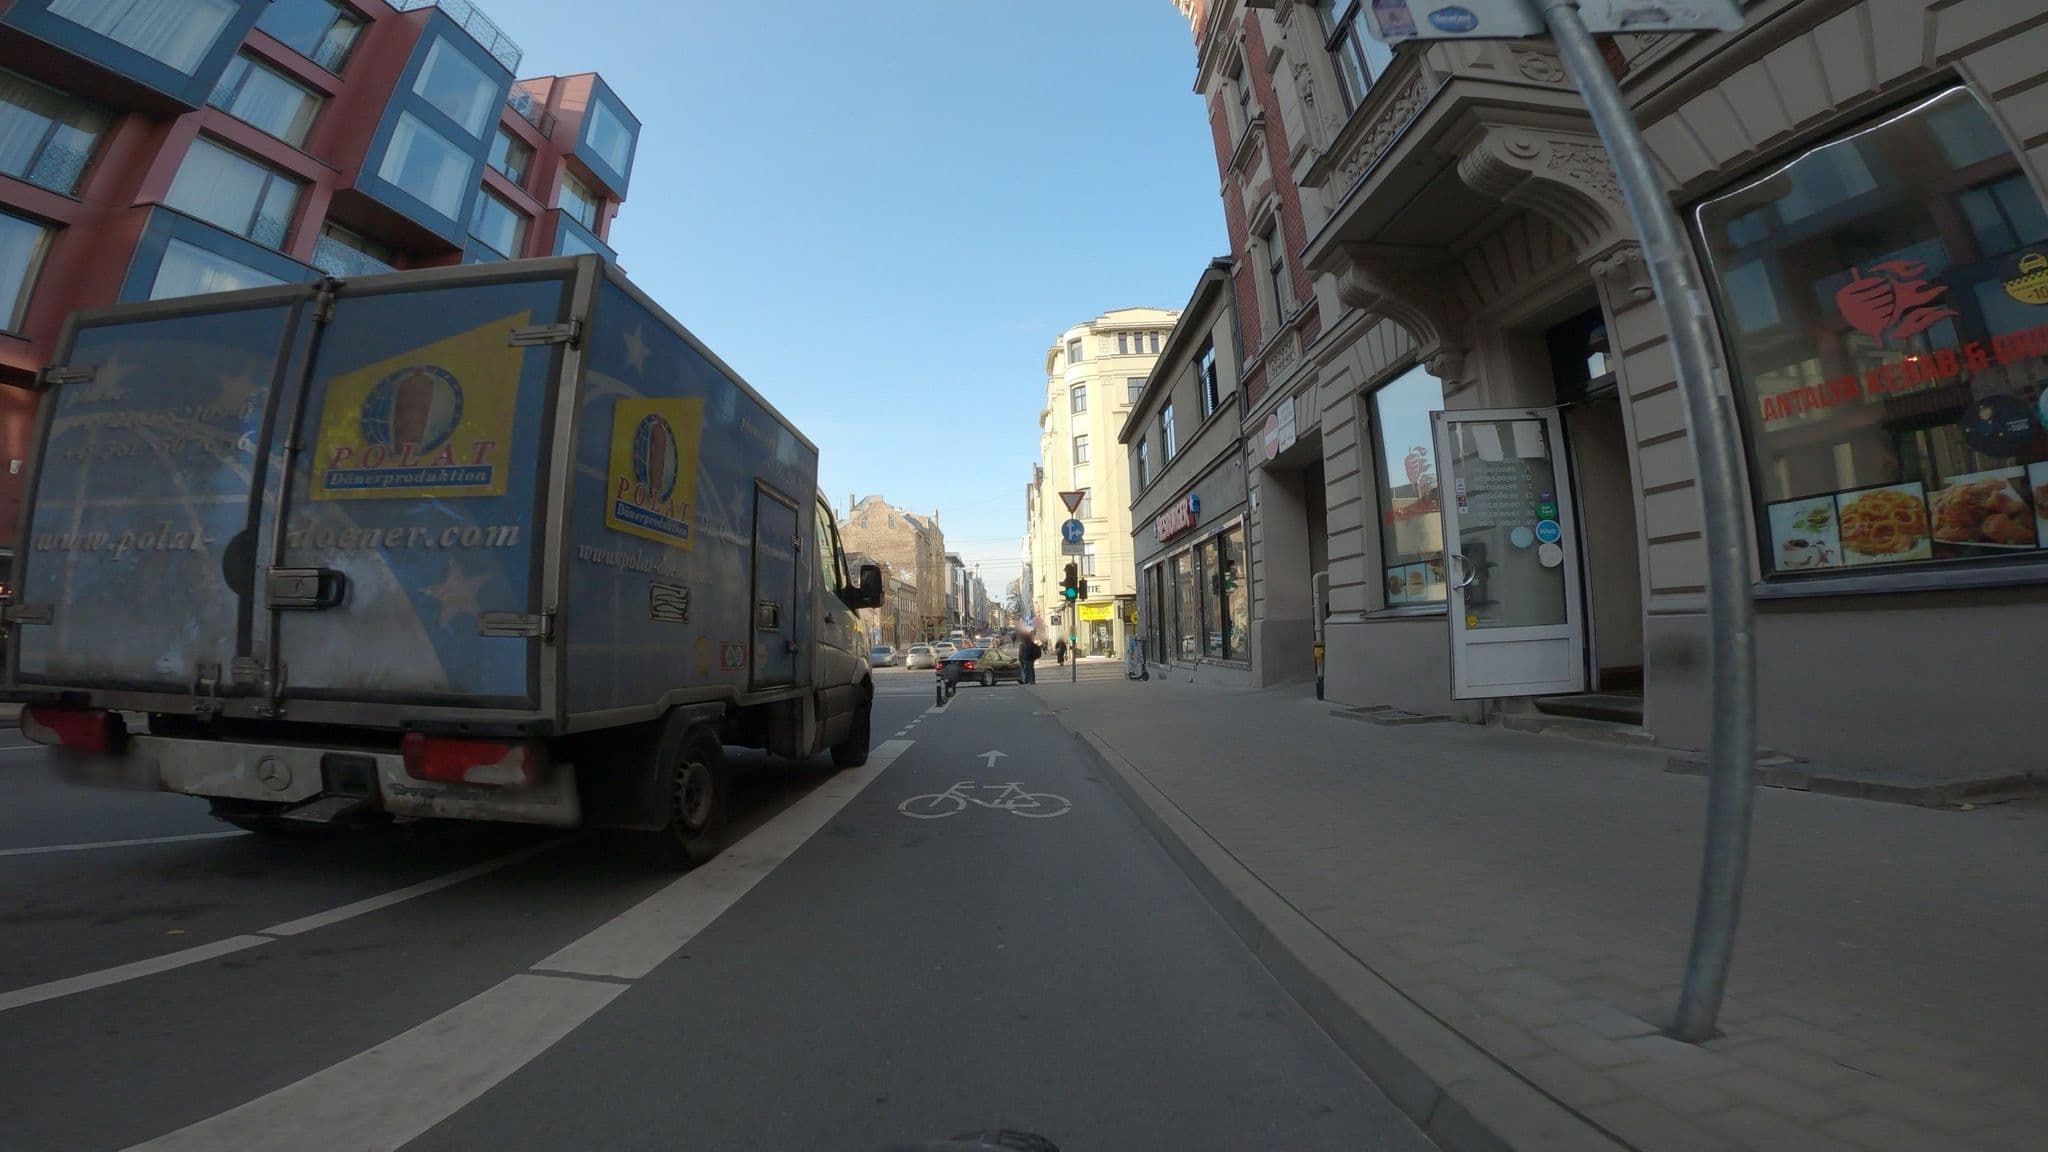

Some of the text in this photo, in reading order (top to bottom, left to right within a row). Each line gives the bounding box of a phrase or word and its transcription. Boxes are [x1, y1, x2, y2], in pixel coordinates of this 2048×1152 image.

[1764, 373, 1861, 423] ANTALYA
[1864, 348, 1959, 394] KEBAB
[1965, 341, 1989, 372] &
[328, 440, 497, 468] POLAT
[615, 473, 691, 522] POLAT
